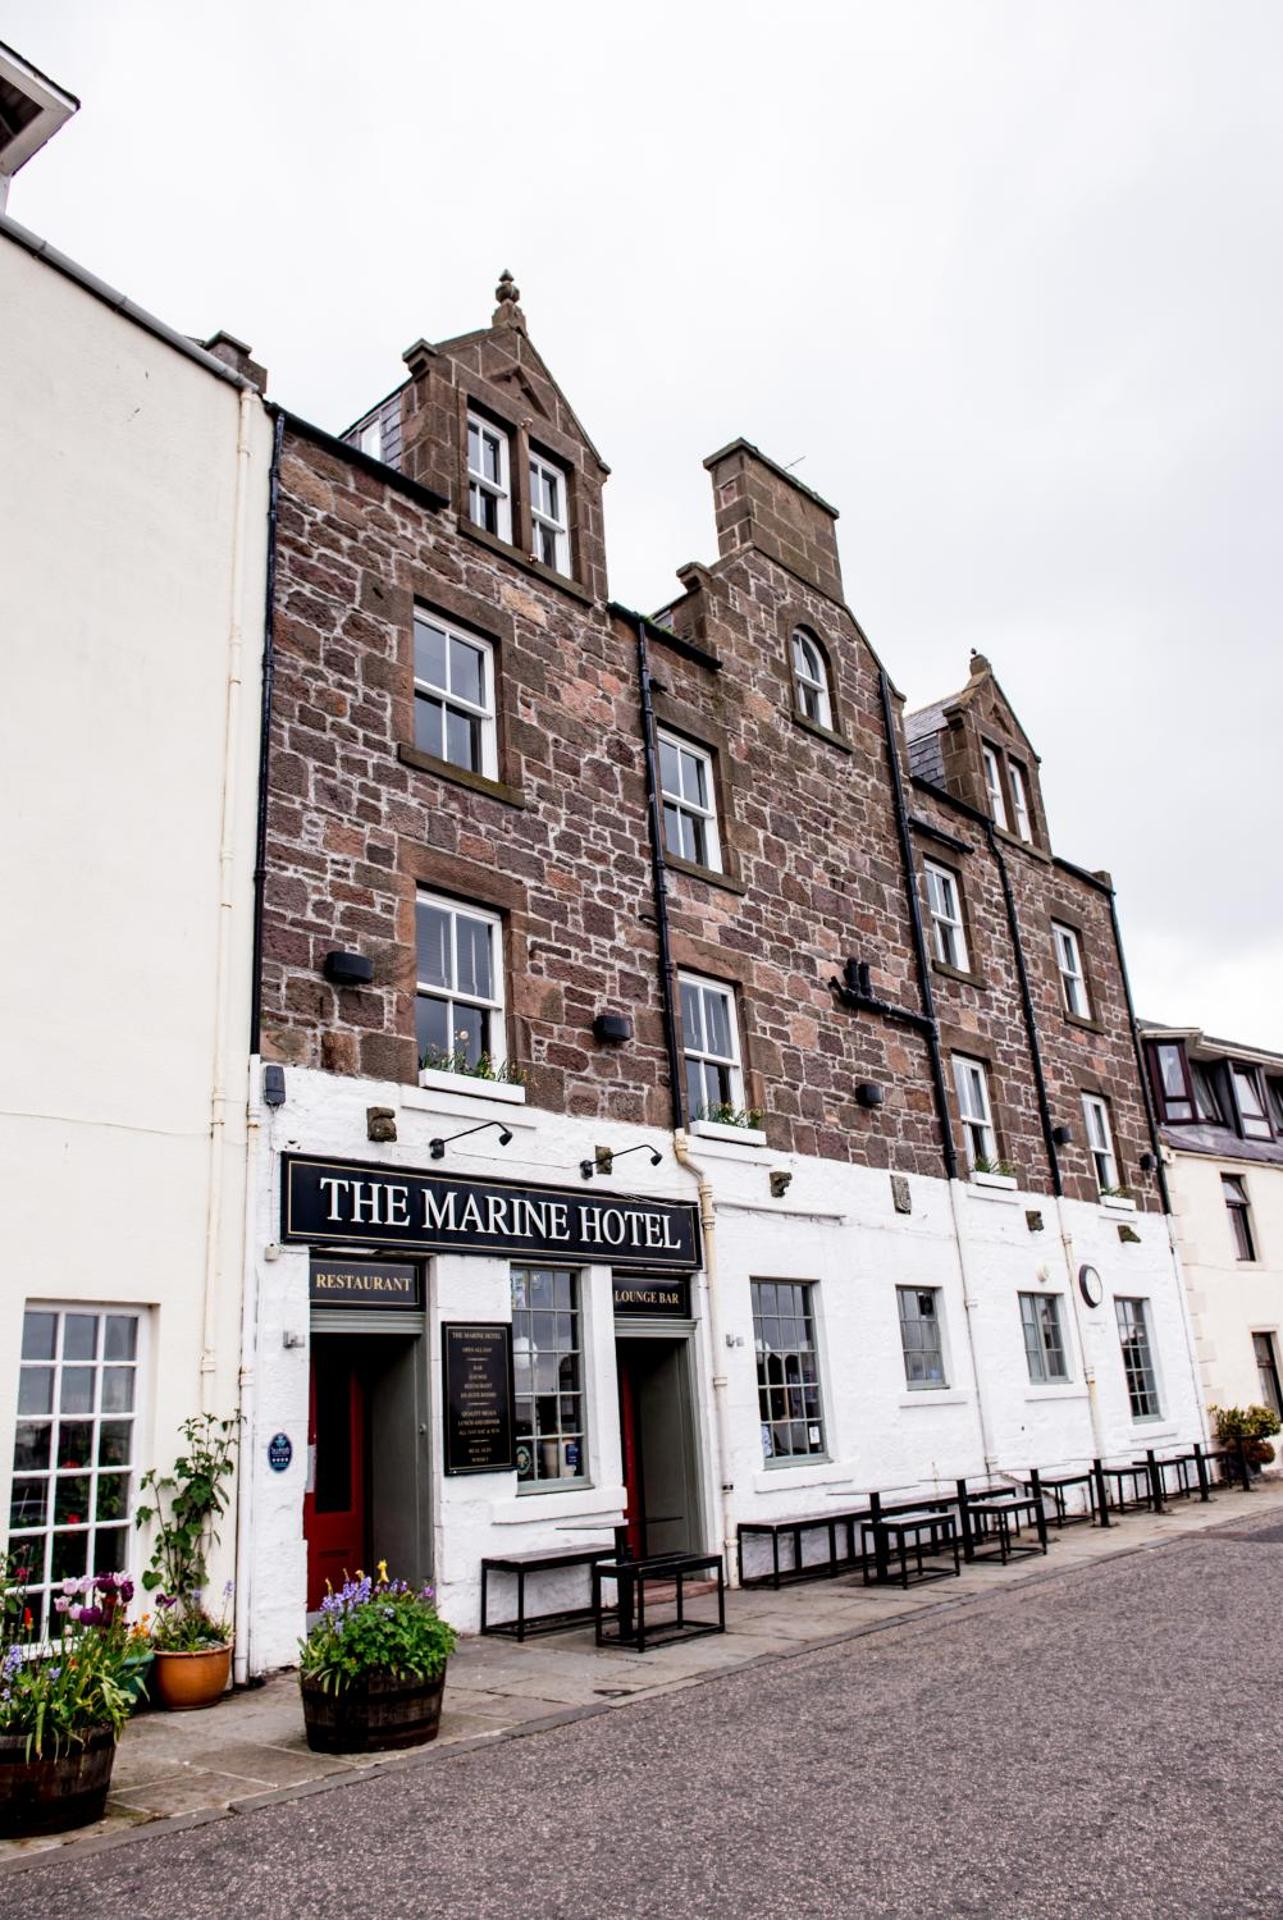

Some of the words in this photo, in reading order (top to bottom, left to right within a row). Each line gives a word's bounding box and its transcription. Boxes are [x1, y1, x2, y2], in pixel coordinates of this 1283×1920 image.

[320, 1177, 411, 1227] THE
[421, 1188, 570, 1241] MARINE
[578, 1206, 682, 1249] HOTEL
[316, 1273, 412, 1292] RESTAURANT
[615, 1290, 658, 1304] LOUNGE
[659, 1292, 680, 1304] BAR
